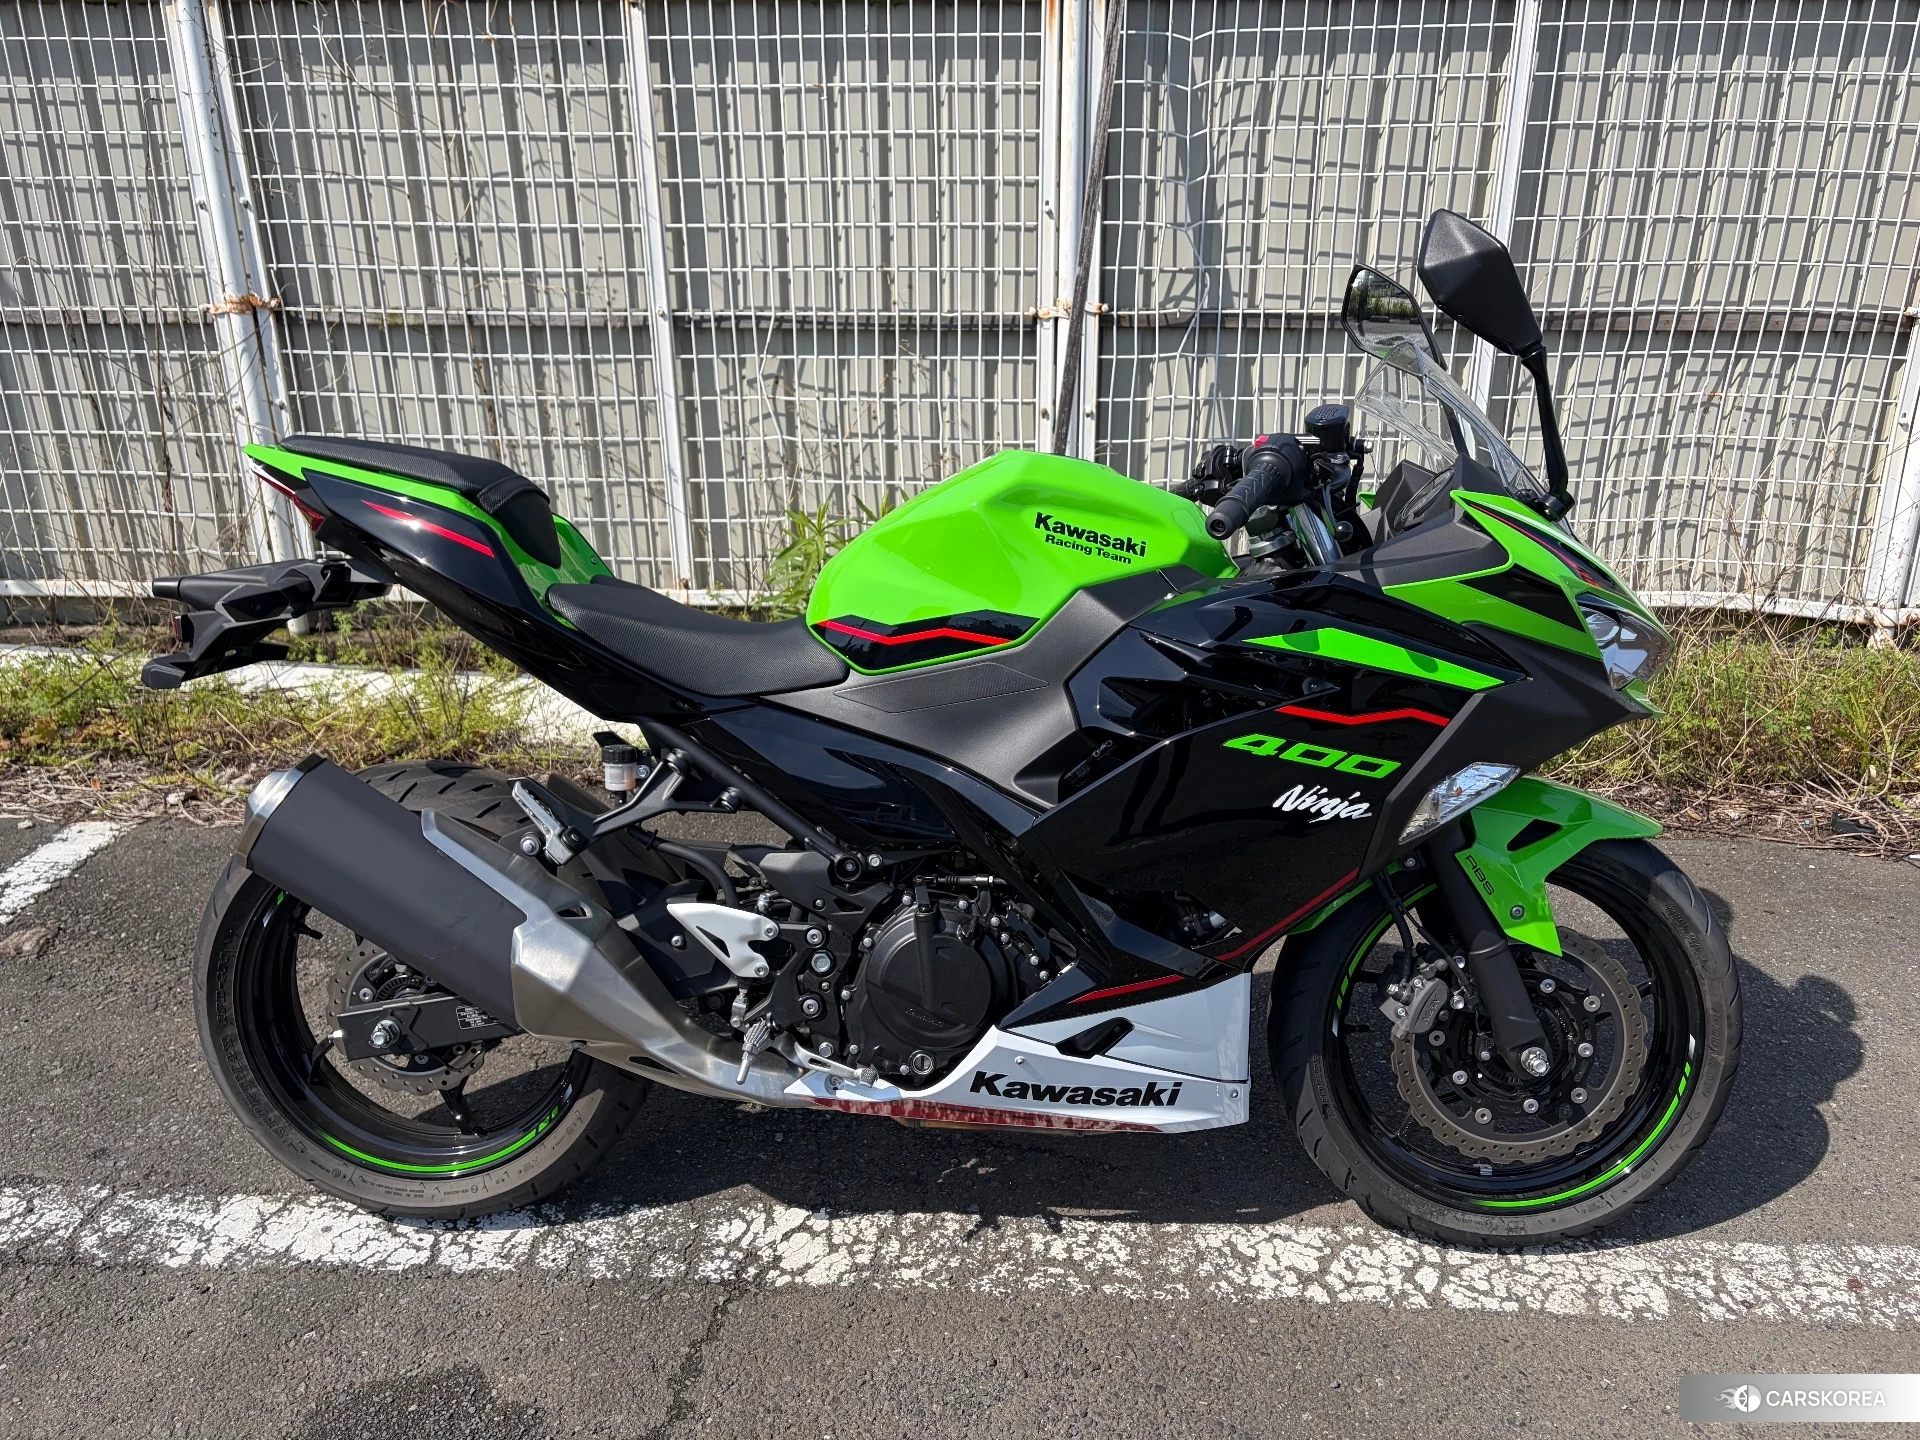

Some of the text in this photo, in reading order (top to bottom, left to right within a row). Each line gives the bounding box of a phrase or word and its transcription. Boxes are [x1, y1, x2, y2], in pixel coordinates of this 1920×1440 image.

[1034, 511, 1147, 557] Kawasaki
[1045, 533, 1132, 564] Racing Team
[1221, 733, 1402, 779] 400
[1272, 784, 1373, 823] Ninja
[1465, 855, 1495, 896] ABS
[969, 1070, 1183, 1107] Kawasaki
